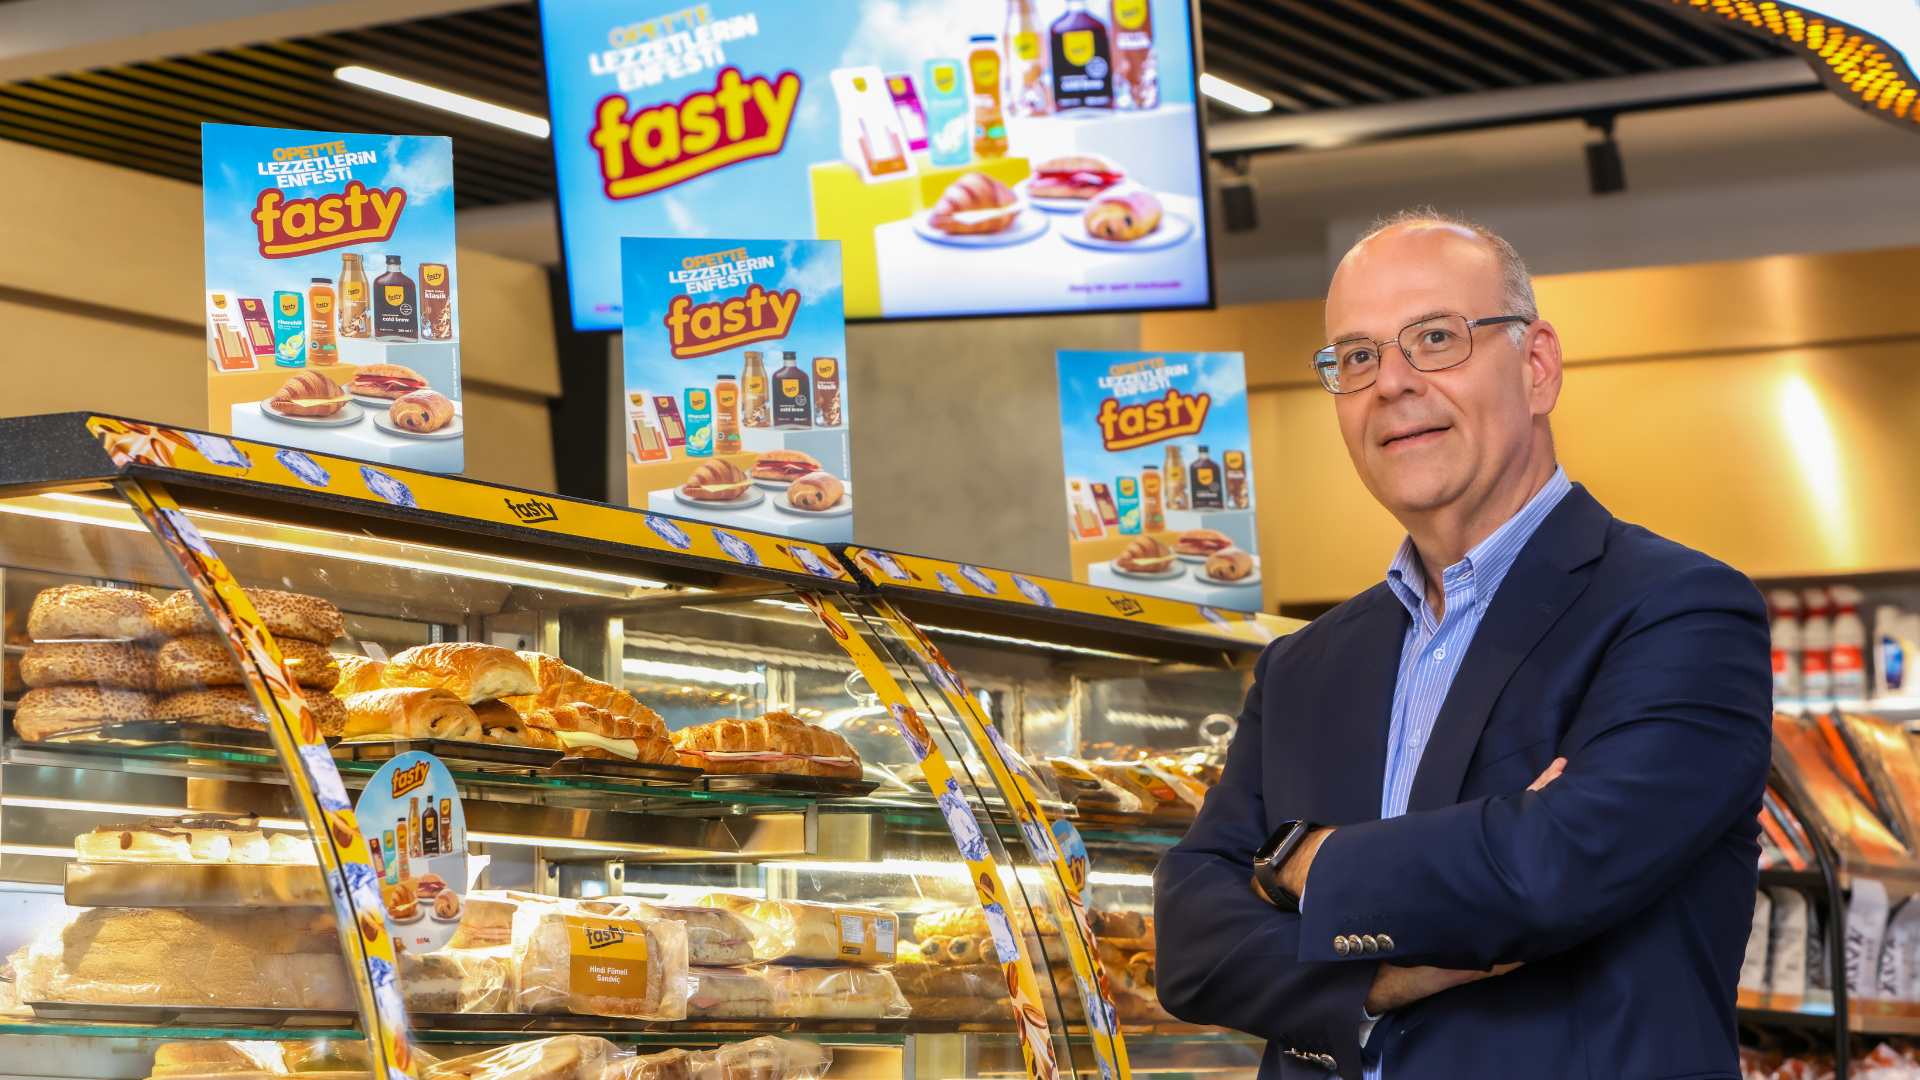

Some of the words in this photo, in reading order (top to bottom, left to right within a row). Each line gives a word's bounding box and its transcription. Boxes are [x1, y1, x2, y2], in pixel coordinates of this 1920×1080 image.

[595, 69, 801, 197] fasty
[272, 140, 348, 162] OPET'TE
[256, 185, 402, 255] fasty
[682, 247, 749, 270] OPET'TE
[427, 272, 441, 281] fasty
[425, 291, 446, 299] klasik
[668, 288, 797, 356] fasty
[1098, 391, 1210, 450] fasty
[504, 498, 558, 524] fasty
[1106, 594, 1144, 616] fasty
[392, 761, 430, 798] fasty
[586, 924, 625, 950] fasty
[589, 966, 606, 974] Hindi
[607, 967, 628, 976] Fümeli
[596, 974, 621, 984] Sandviç
